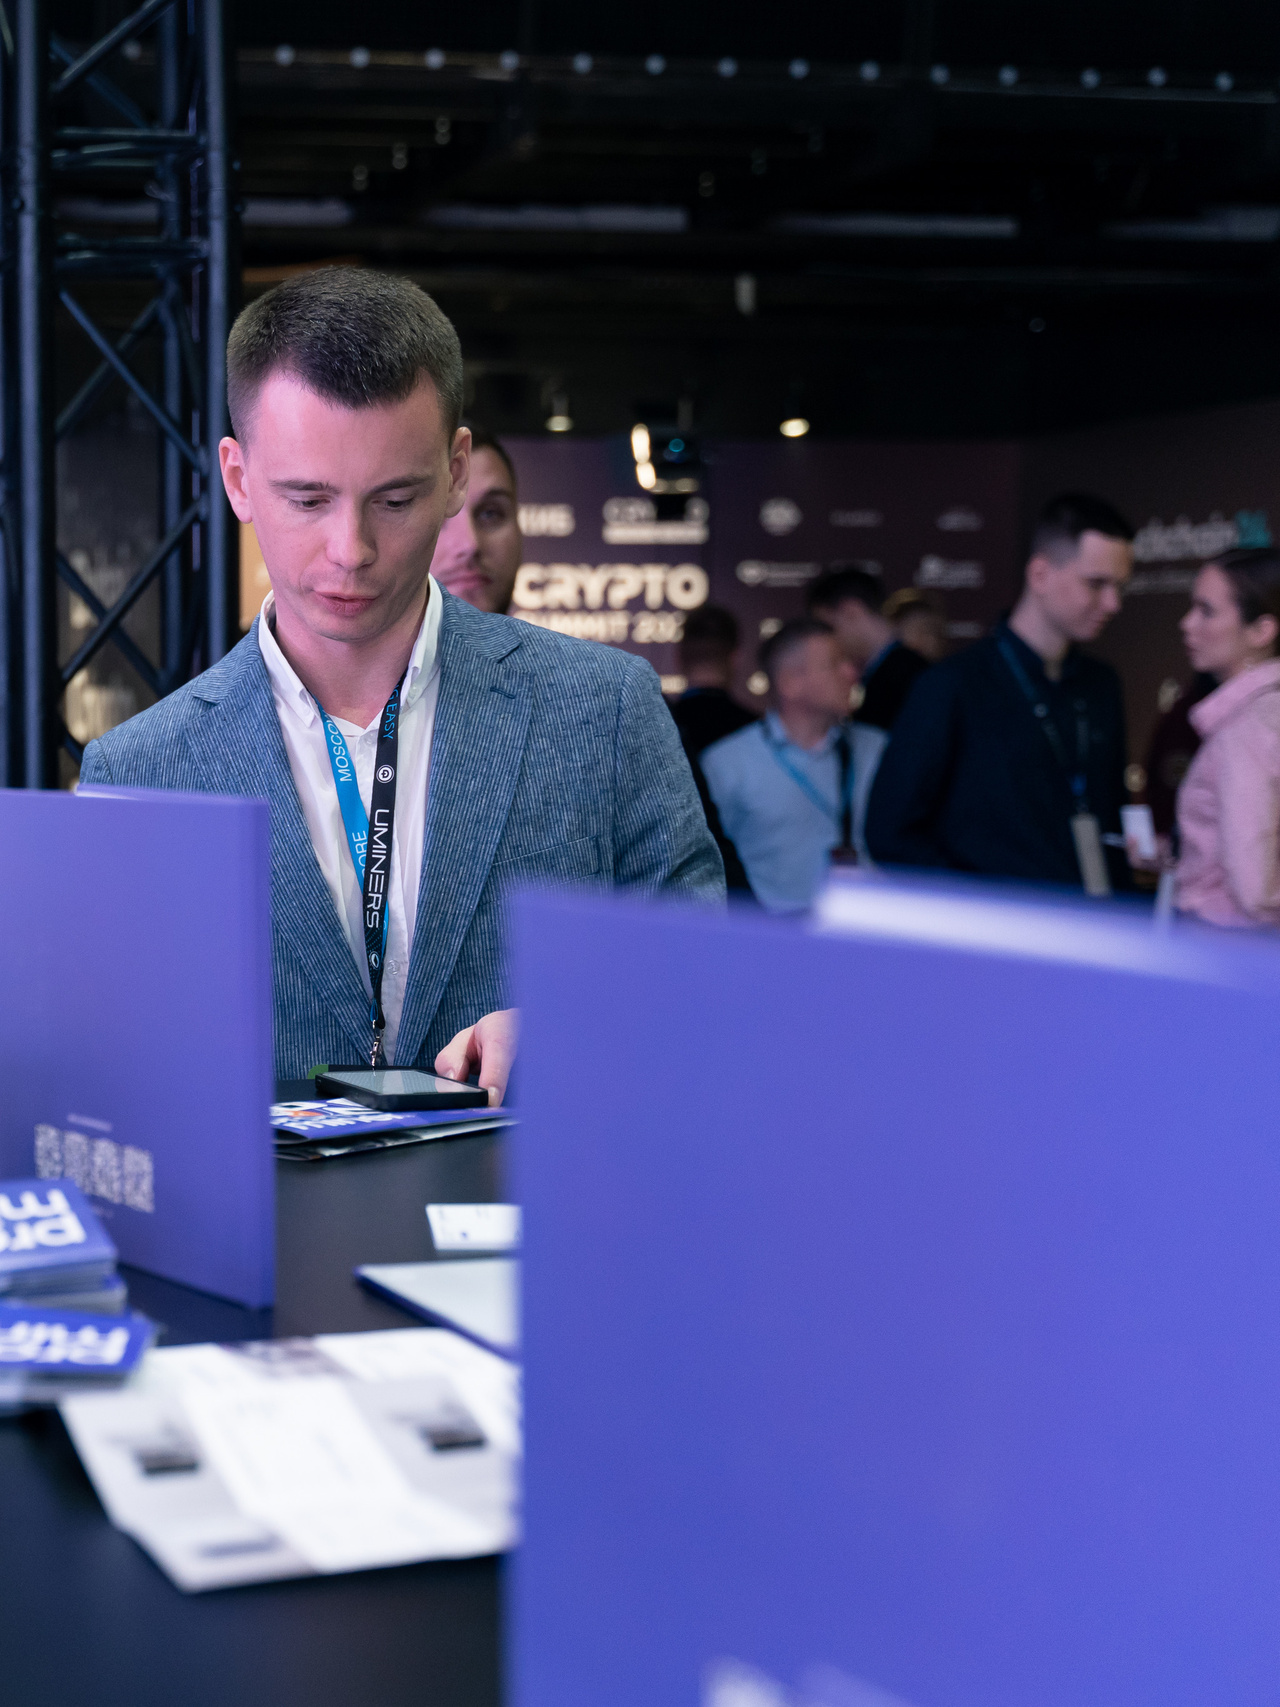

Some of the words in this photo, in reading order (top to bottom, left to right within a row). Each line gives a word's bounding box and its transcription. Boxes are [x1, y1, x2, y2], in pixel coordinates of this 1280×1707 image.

[513, 563, 709, 610] CRYPTO
[383, 703, 398, 739] EASY
[365, 808, 389, 929] UMINERS
